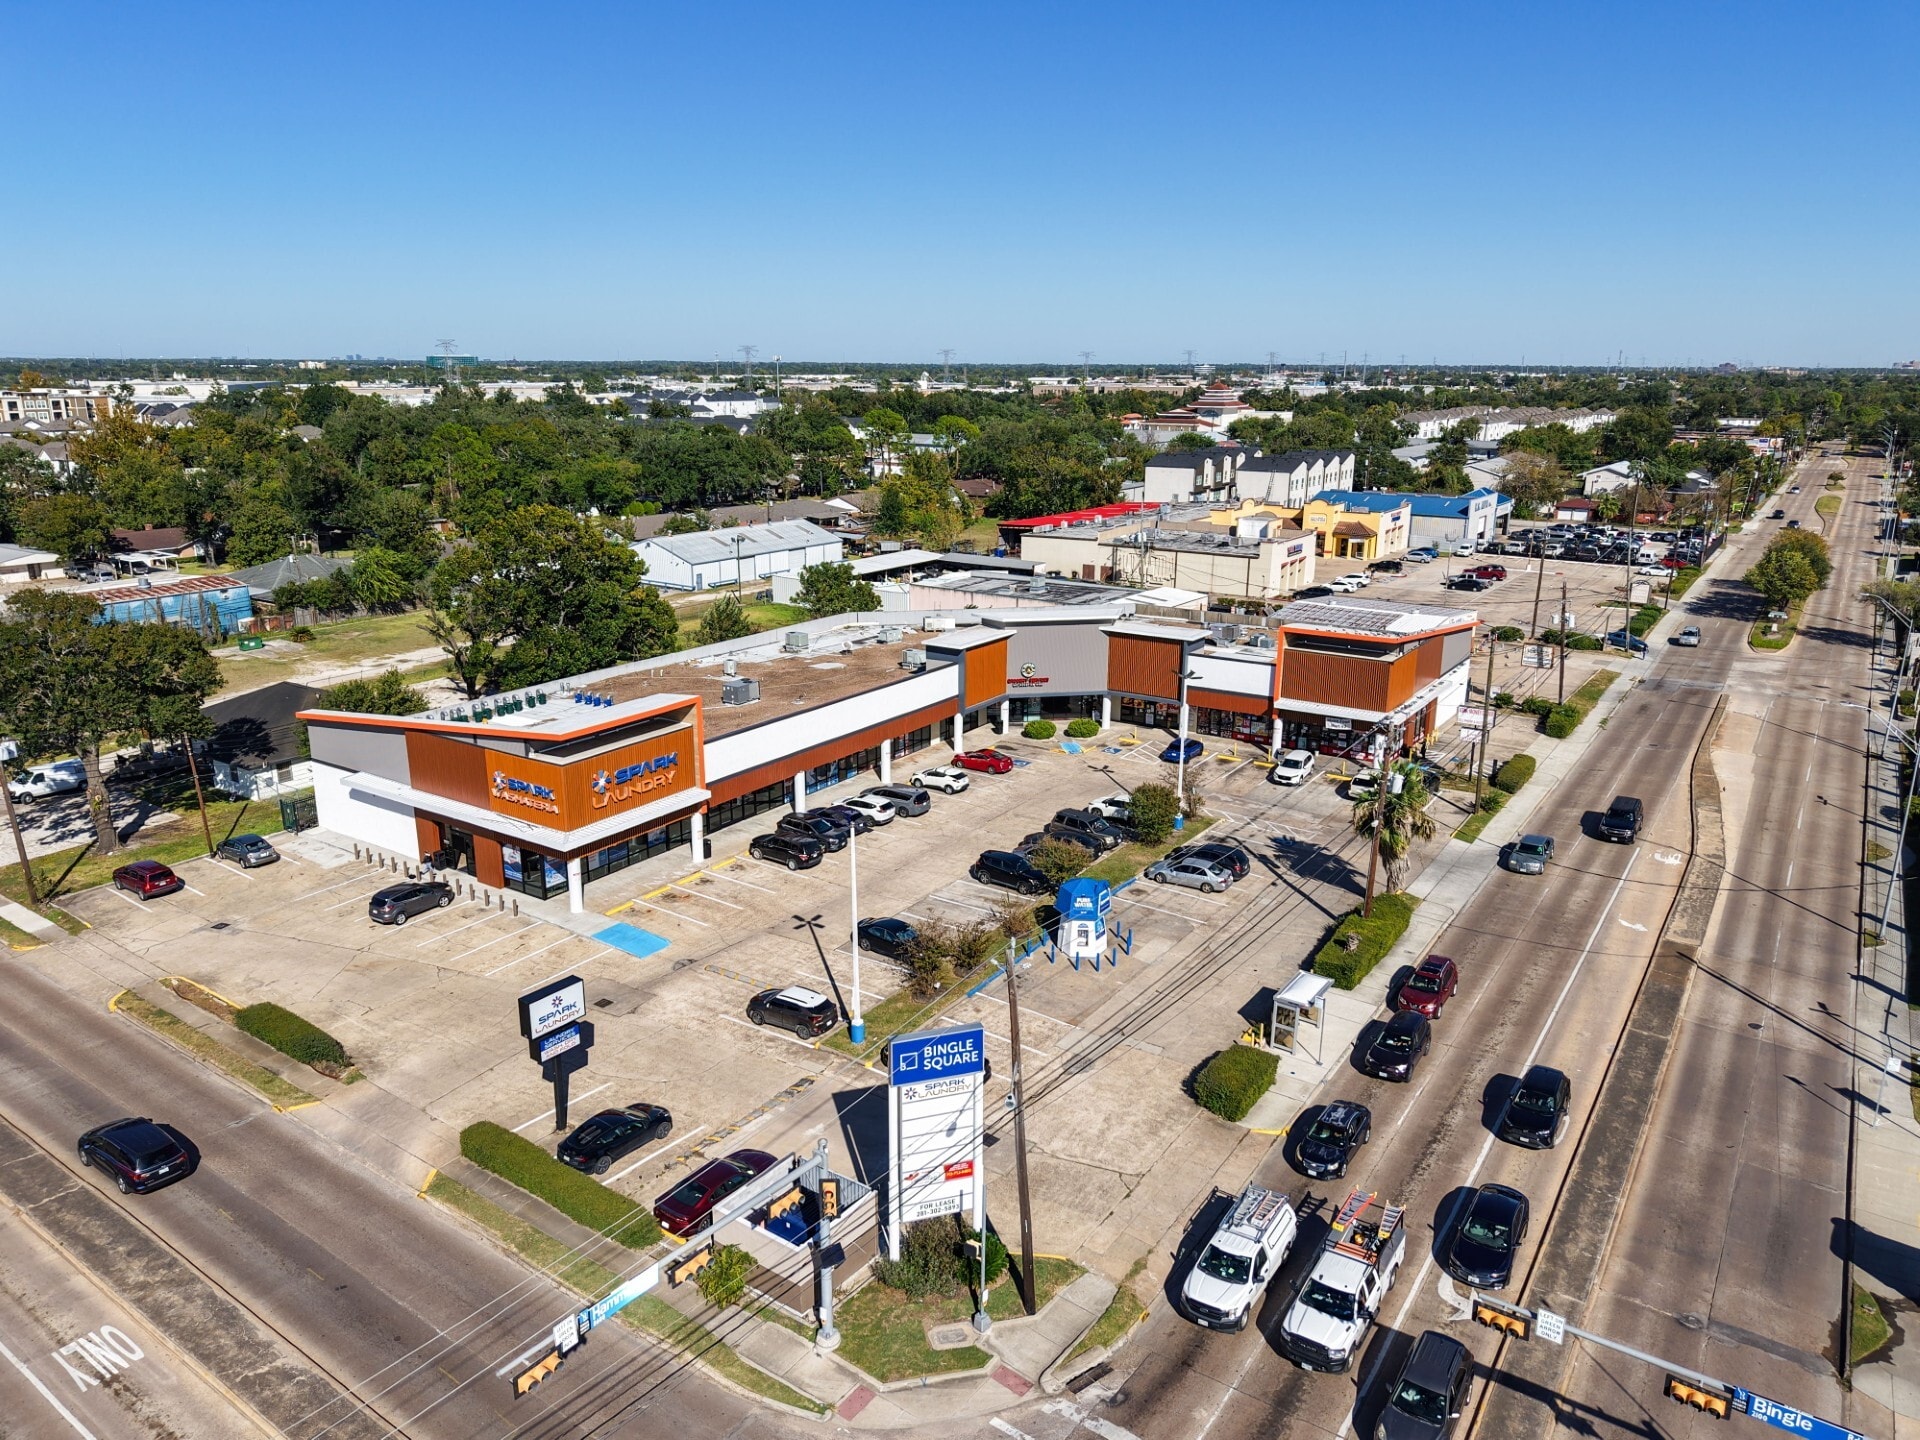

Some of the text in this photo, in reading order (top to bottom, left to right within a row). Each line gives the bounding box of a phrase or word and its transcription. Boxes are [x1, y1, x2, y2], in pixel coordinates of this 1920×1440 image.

[614, 752, 678, 784] SPARK
[507, 778, 555, 801] SPARK
[592, 770, 676, 810] LAUNDRY
[491, 787, 560, 815] WASHATERIA
[535, 1008, 581, 1034] LAUNDRY
[538, 1001, 577, 1025] SPARK
[923, 1038, 974, 1058] BINGLE
[923, 1050, 979, 1070] SQUARE
[918, 1083, 972, 1098] LAUNDRY
[924, 1078, 965, 1091] SPARK
[919, 1198, 956, 1211] FOR LEASE
[1539, 1324, 1560, 1335] ARROW
[1540, 1319, 1561, 1330] GREEN
[1541, 1330, 1557, 1339] ONLY
[51, 1325, 145, 1392] ONLY
[1751, 1410, 1768, 1422] 2100
[1753, 1397, 1813, 1431] Bingle
